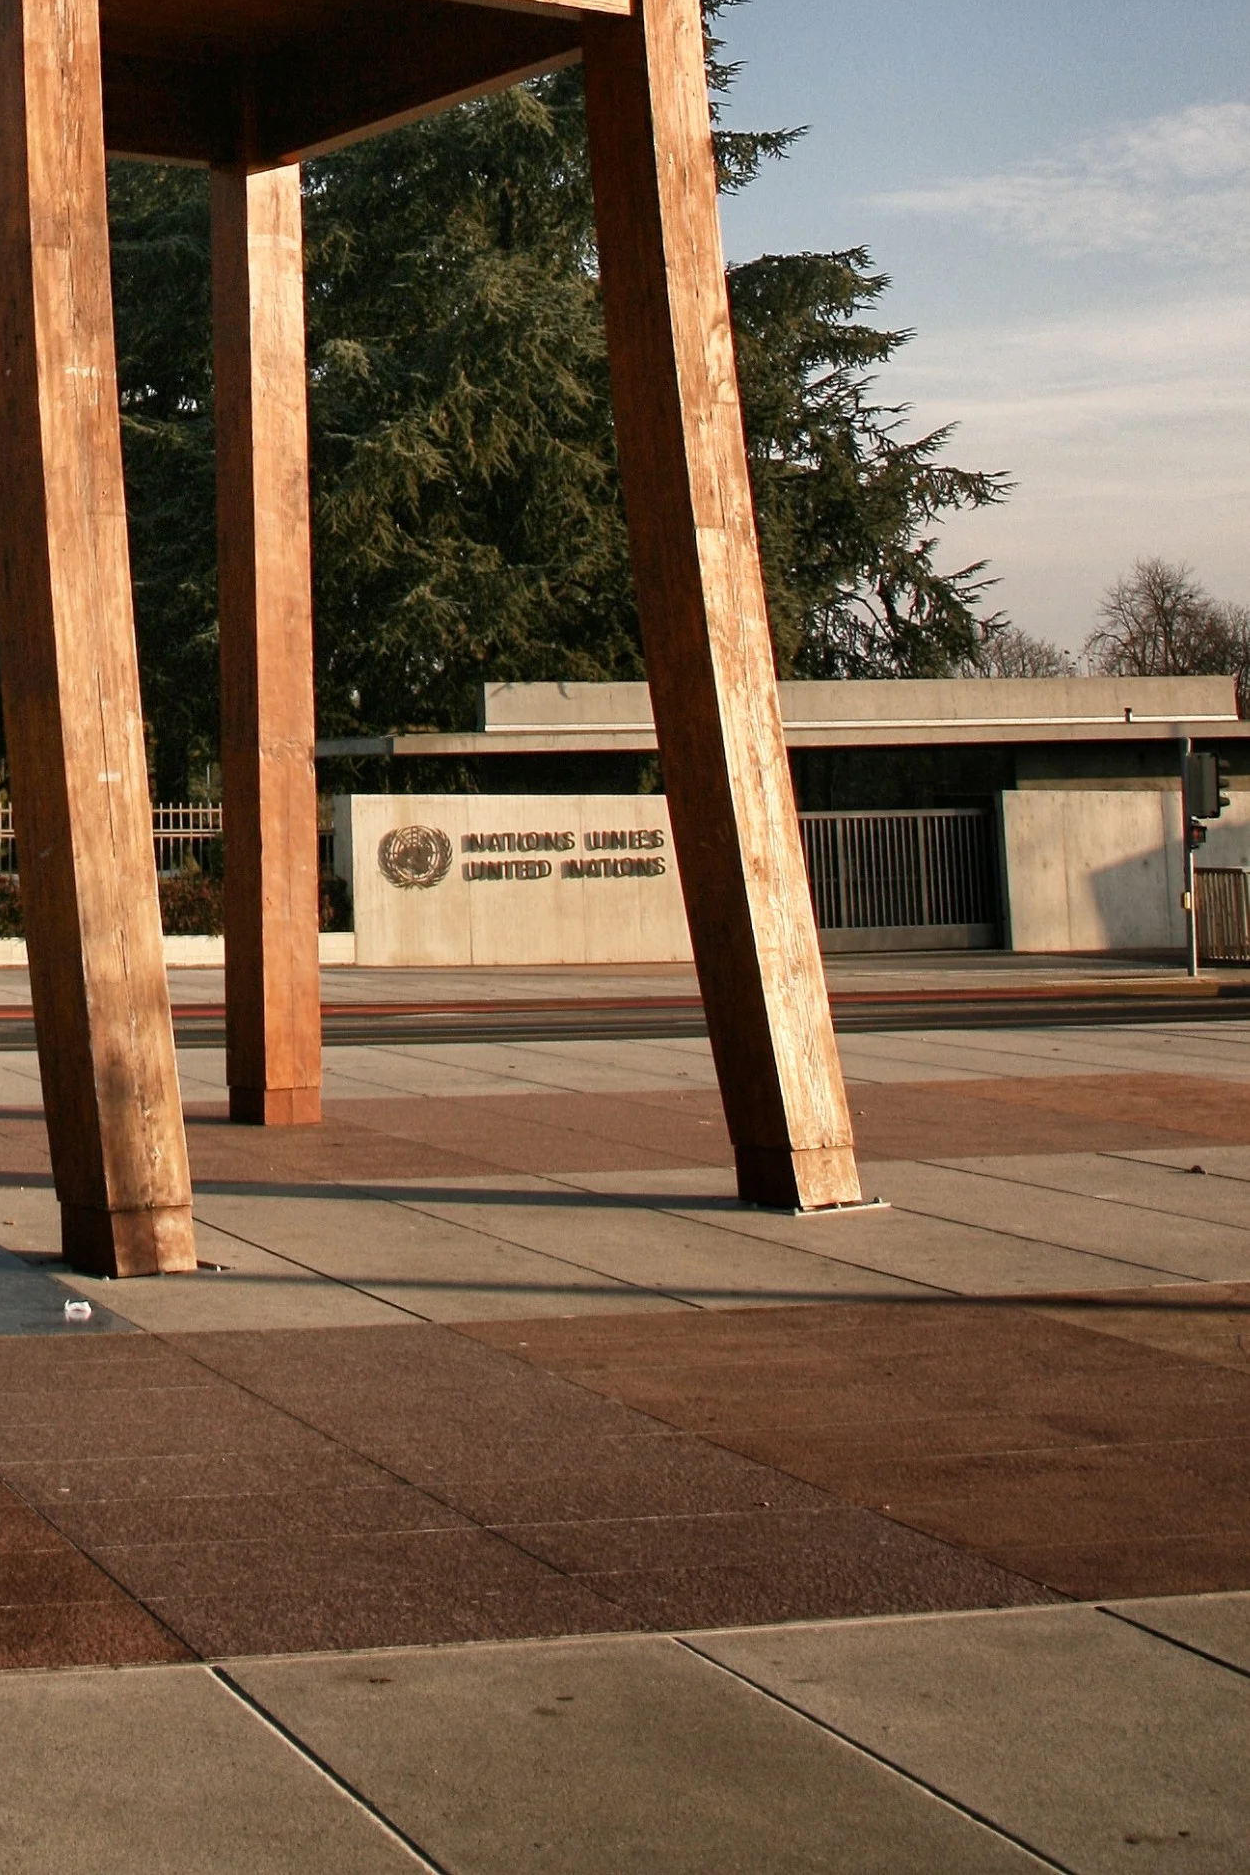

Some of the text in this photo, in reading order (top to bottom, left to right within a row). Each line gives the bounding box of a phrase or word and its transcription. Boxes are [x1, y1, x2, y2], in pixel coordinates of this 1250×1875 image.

[461, 829, 664, 853] NATIONS UNIES
[461, 857, 666, 881] UNITED NATIONS
